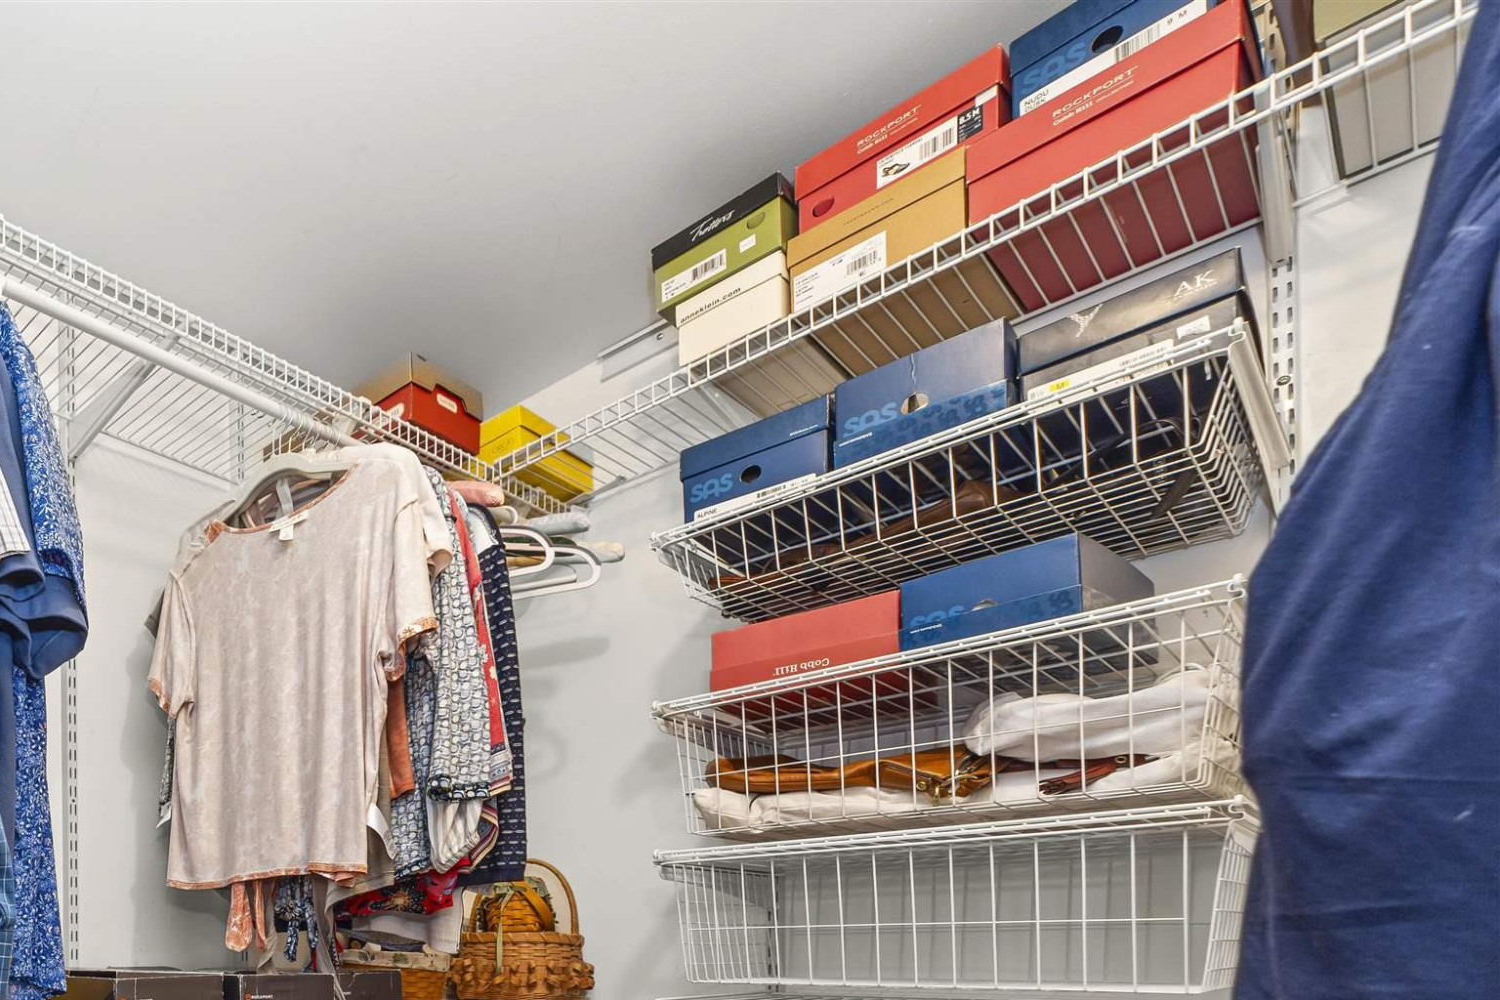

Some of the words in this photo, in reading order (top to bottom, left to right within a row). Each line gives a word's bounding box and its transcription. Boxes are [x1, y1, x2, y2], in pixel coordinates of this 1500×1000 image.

[1024, 89, 1049, 106] NUDU
[1052, 65, 1138, 117] ROCKPORT
[857, 104, 921, 147] ROCKPORT
[680, 287, 742, 324] anneklein.com
[800, 657, 830, 670] Cobb
